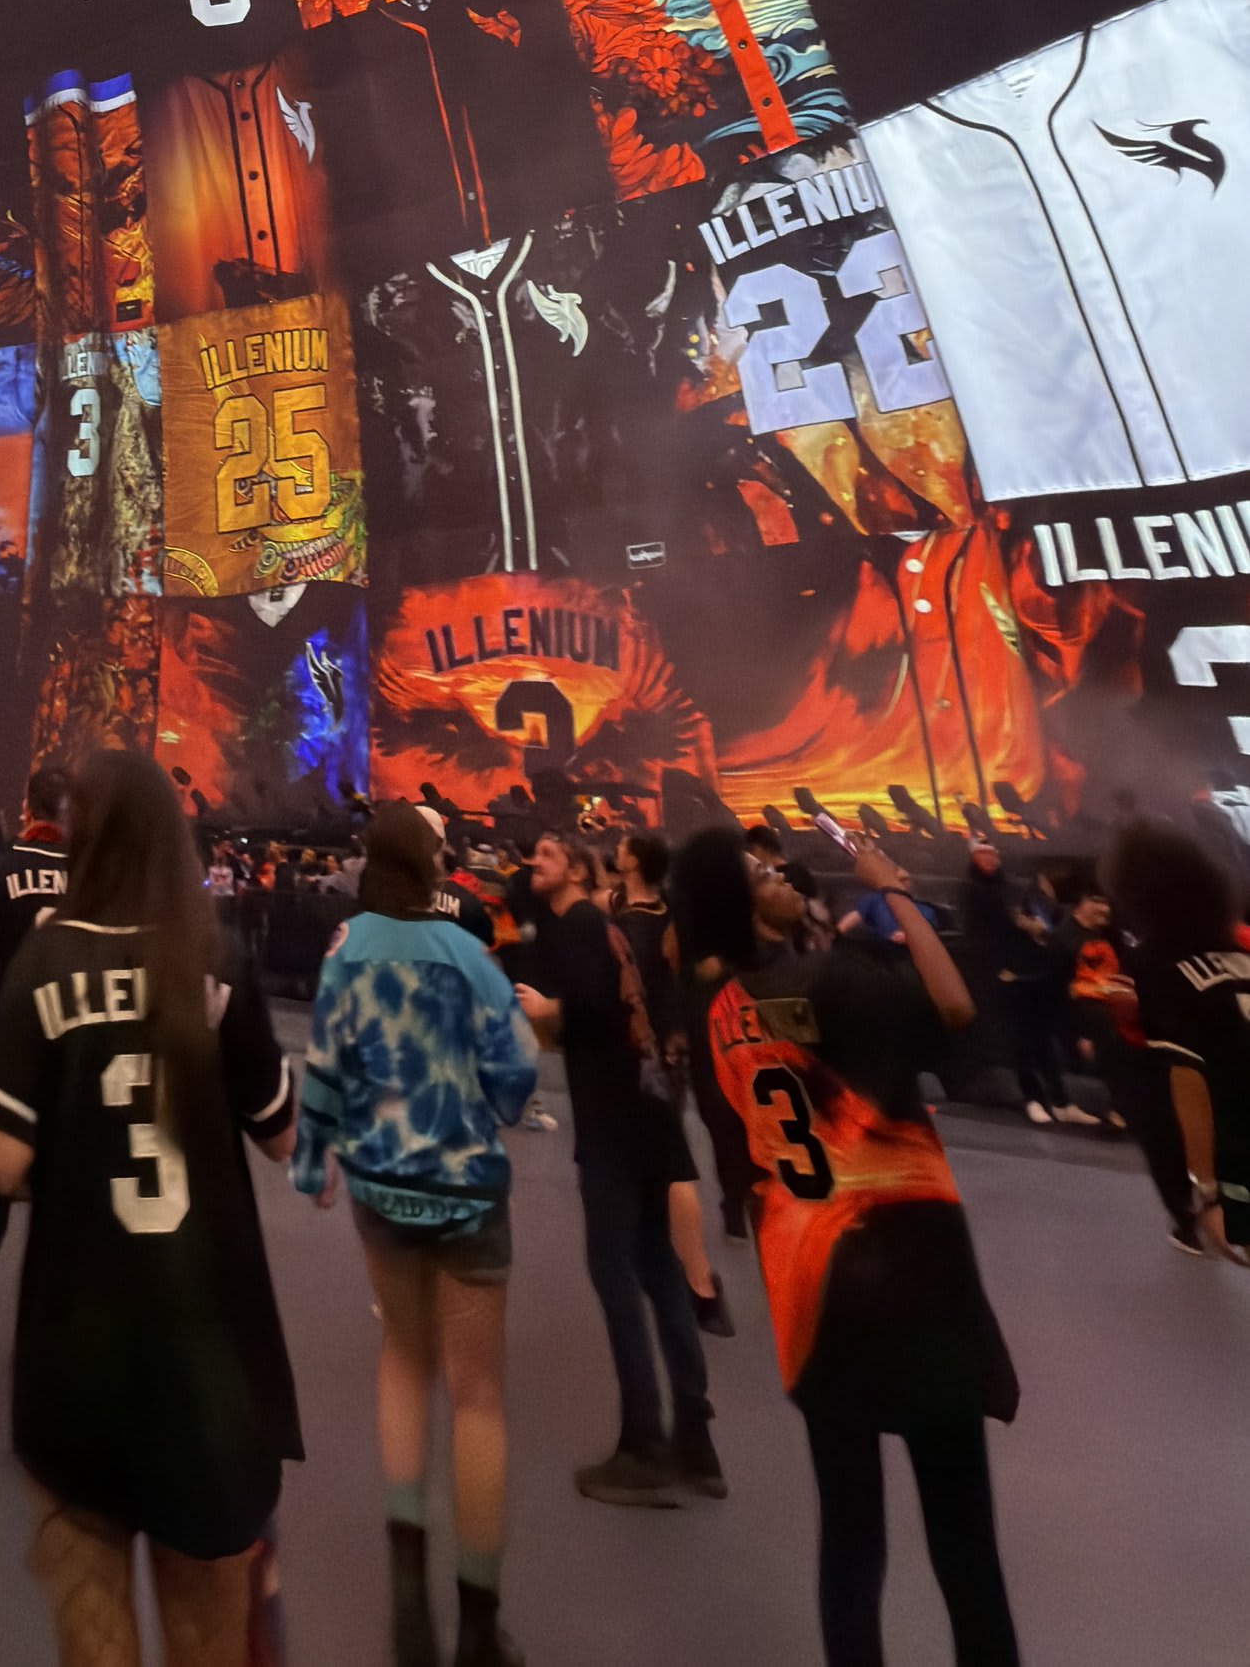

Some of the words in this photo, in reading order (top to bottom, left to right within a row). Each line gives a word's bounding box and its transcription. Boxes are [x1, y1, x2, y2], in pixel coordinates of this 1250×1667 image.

[200, 330, 328, 392] ILLENIUM
[724, 230, 952, 435] 22
[67, 389, 100, 479] 3
[214, 384, 331, 534] 25
[426, 608, 619, 673] ILLENIUM
[100, 1053, 190, 1234] 3
[752, 1067, 834, 1200] 3
